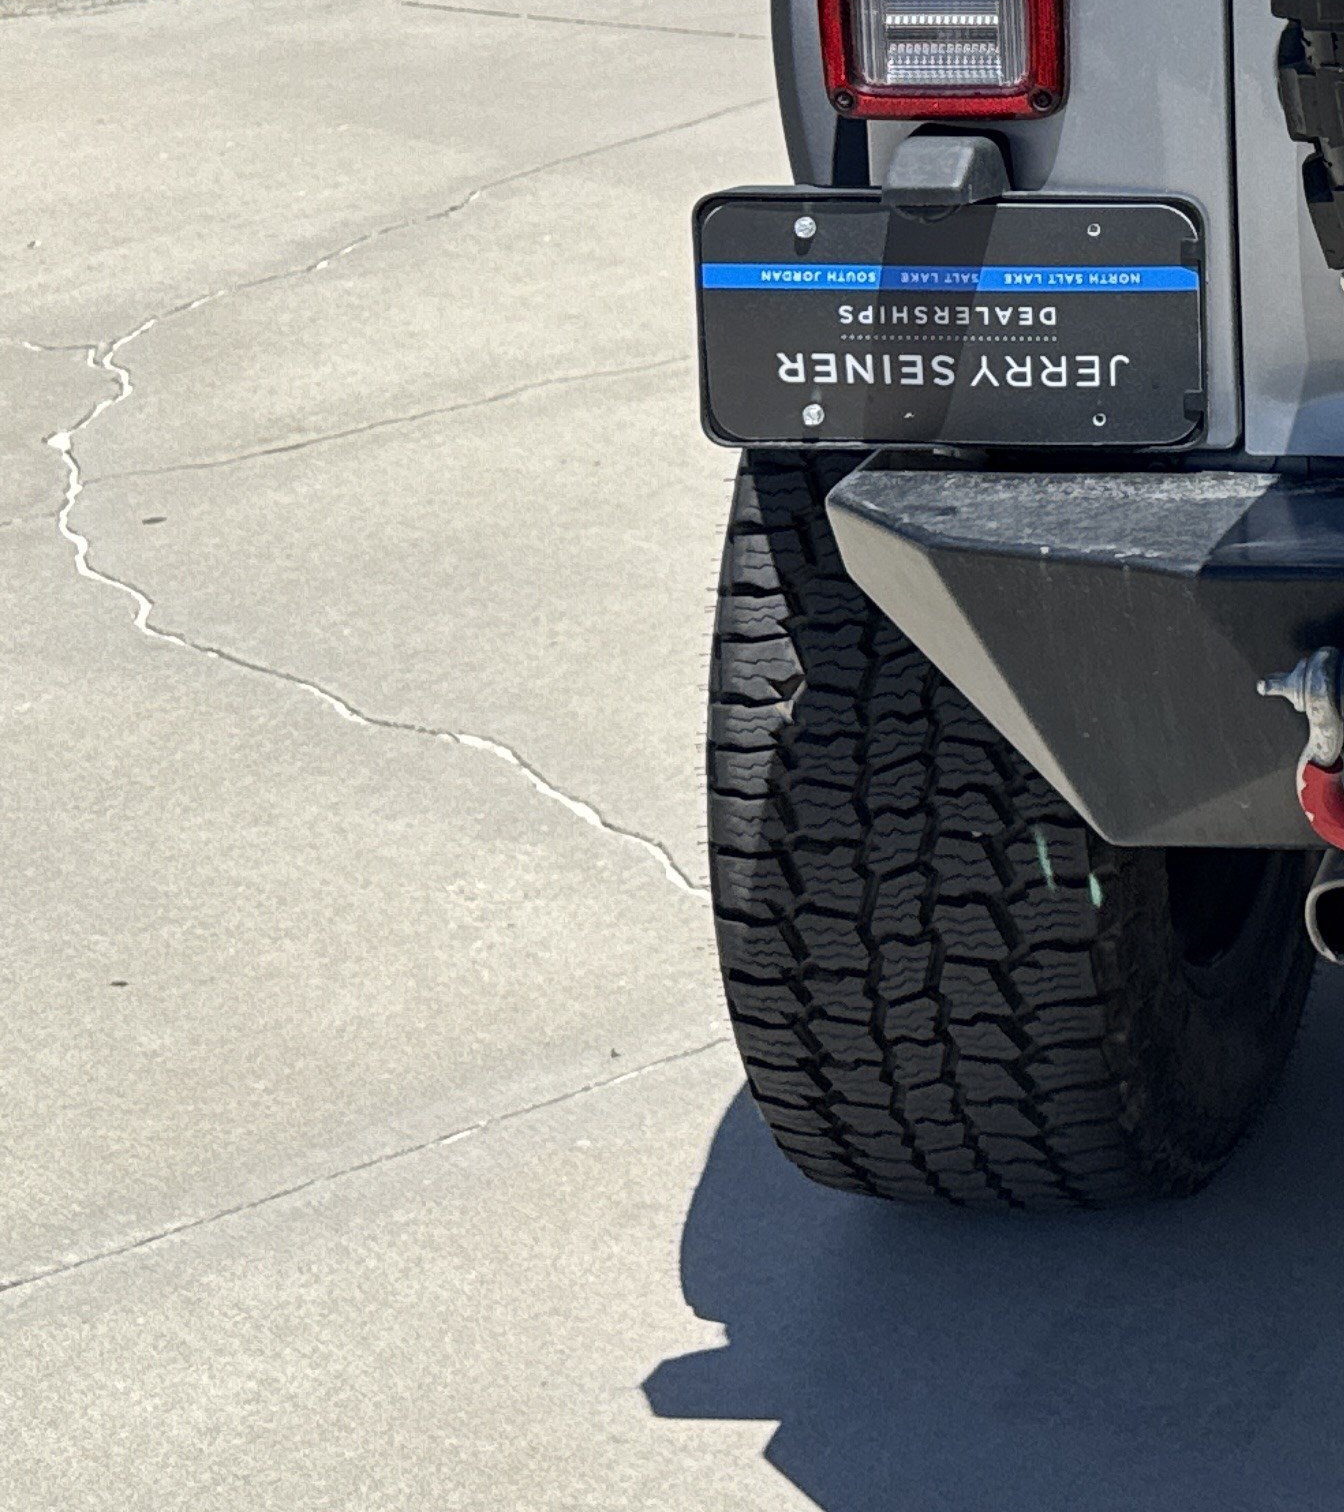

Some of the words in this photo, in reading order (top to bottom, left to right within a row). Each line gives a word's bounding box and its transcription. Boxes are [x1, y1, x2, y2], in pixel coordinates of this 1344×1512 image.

[760, 270, 822, 283] JORDAN
[827, 271, 876, 283] SOUTH
[900, 271, 940, 284] LAKE
[944, 272, 980, 284] SALT
[1004, 272, 1043, 285] LAKE
[1048, 272, 1083, 285] SALT
[1088, 272, 1141, 285] NORTH
[838, 305, 1057, 326] DEALERSHIPS
[776, 352, 955, 386] SEINER
[970, 354, 1130, 387] JERRY
